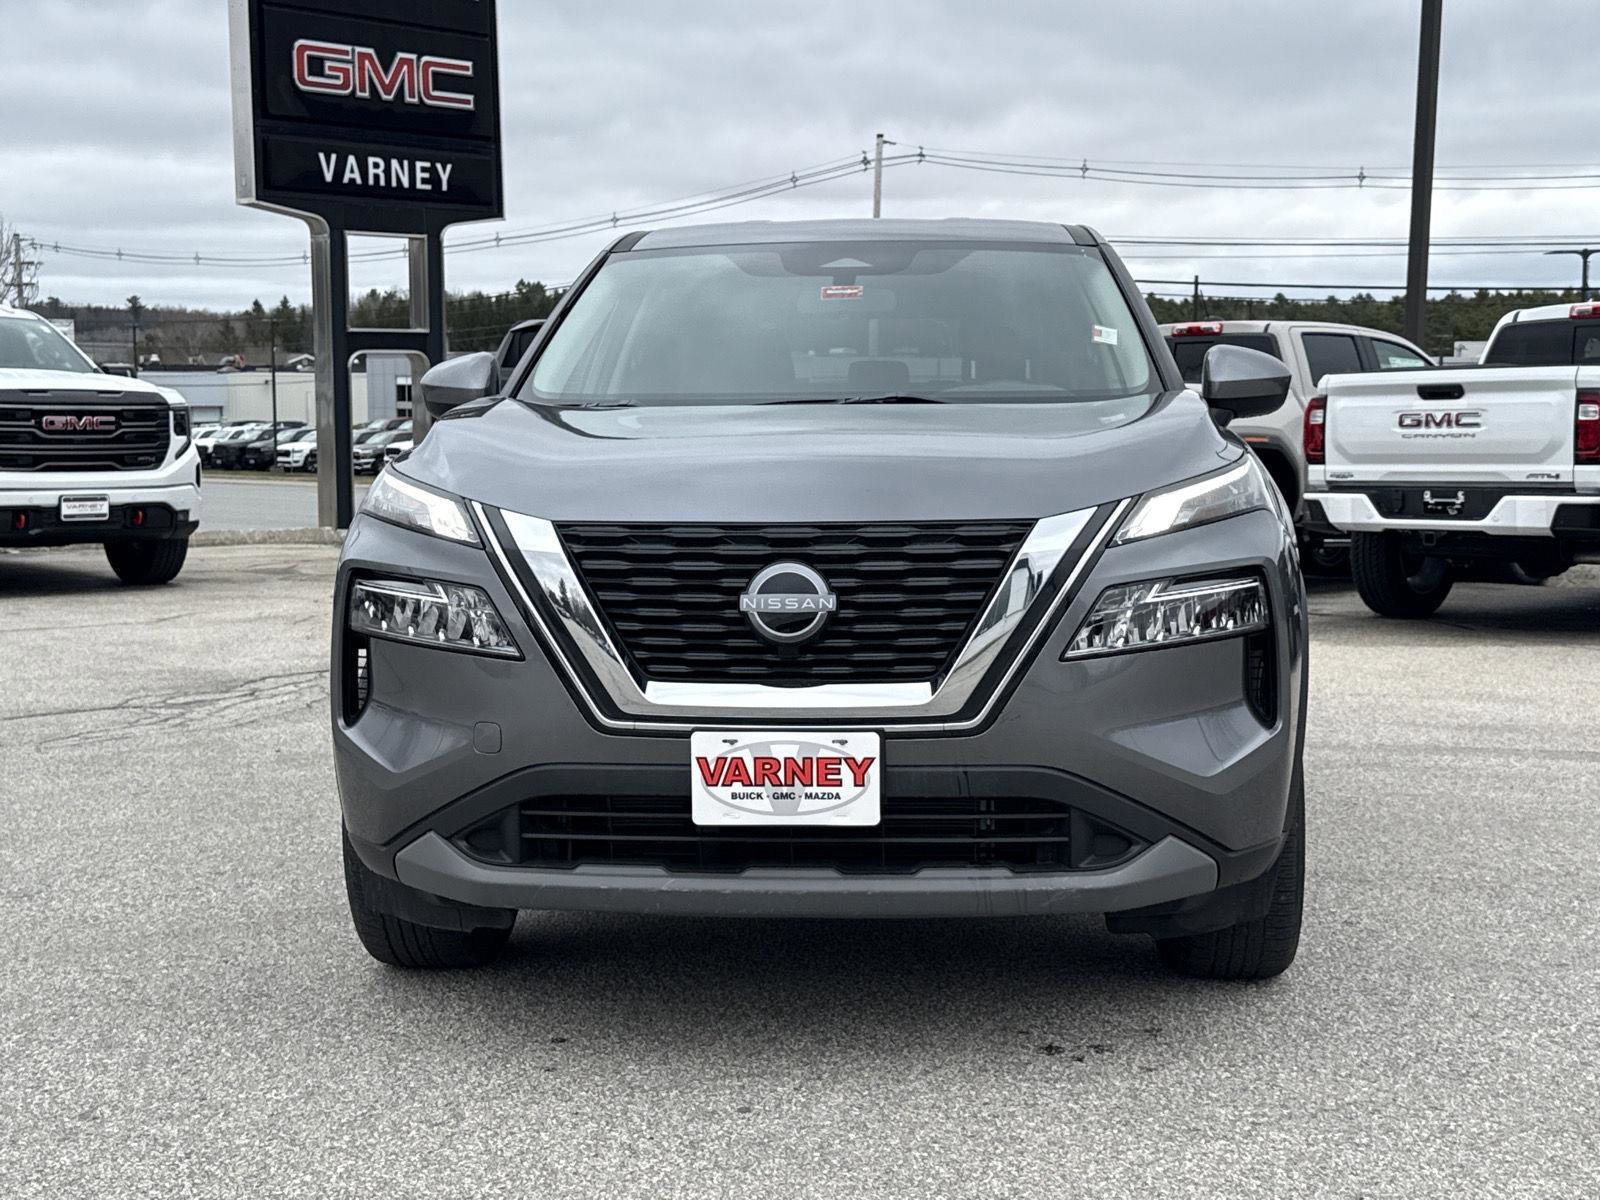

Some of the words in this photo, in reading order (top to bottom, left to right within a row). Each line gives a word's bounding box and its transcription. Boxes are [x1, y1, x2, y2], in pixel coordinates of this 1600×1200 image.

[292, 39, 476, 110] GMC
[318, 152, 453, 191] VARNEY
[42, 415, 116, 431] GMC
[1398, 412, 1482, 429] GMC
[743, 598, 833, 609] NISSAN
[695, 756, 876, 787] VARNEY
[731, 791, 764, 800] BUICK
[772, 791, 796, 800] GMC
[804, 791, 841, 800] MAZDA
